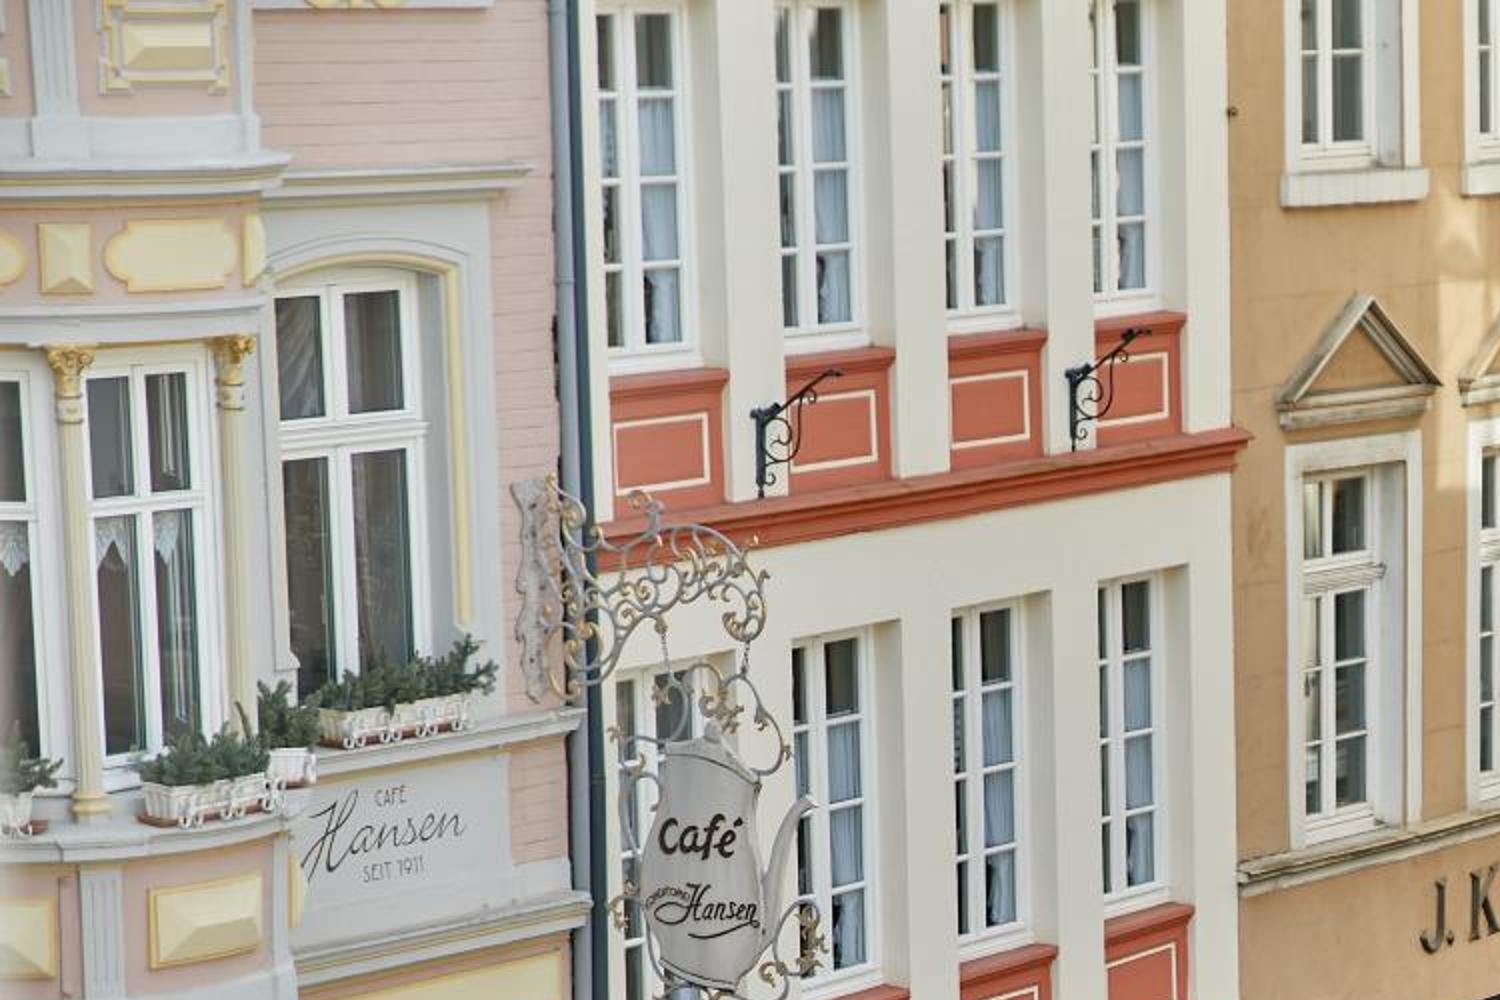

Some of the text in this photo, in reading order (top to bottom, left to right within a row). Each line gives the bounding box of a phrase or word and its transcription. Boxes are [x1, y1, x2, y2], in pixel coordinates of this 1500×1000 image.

[301, 789, 466, 884] Hansen
[658, 813, 744, 861] Café
[363, 855, 424, 883] SEIT 1911
[653, 883, 760, 926] Hansen
